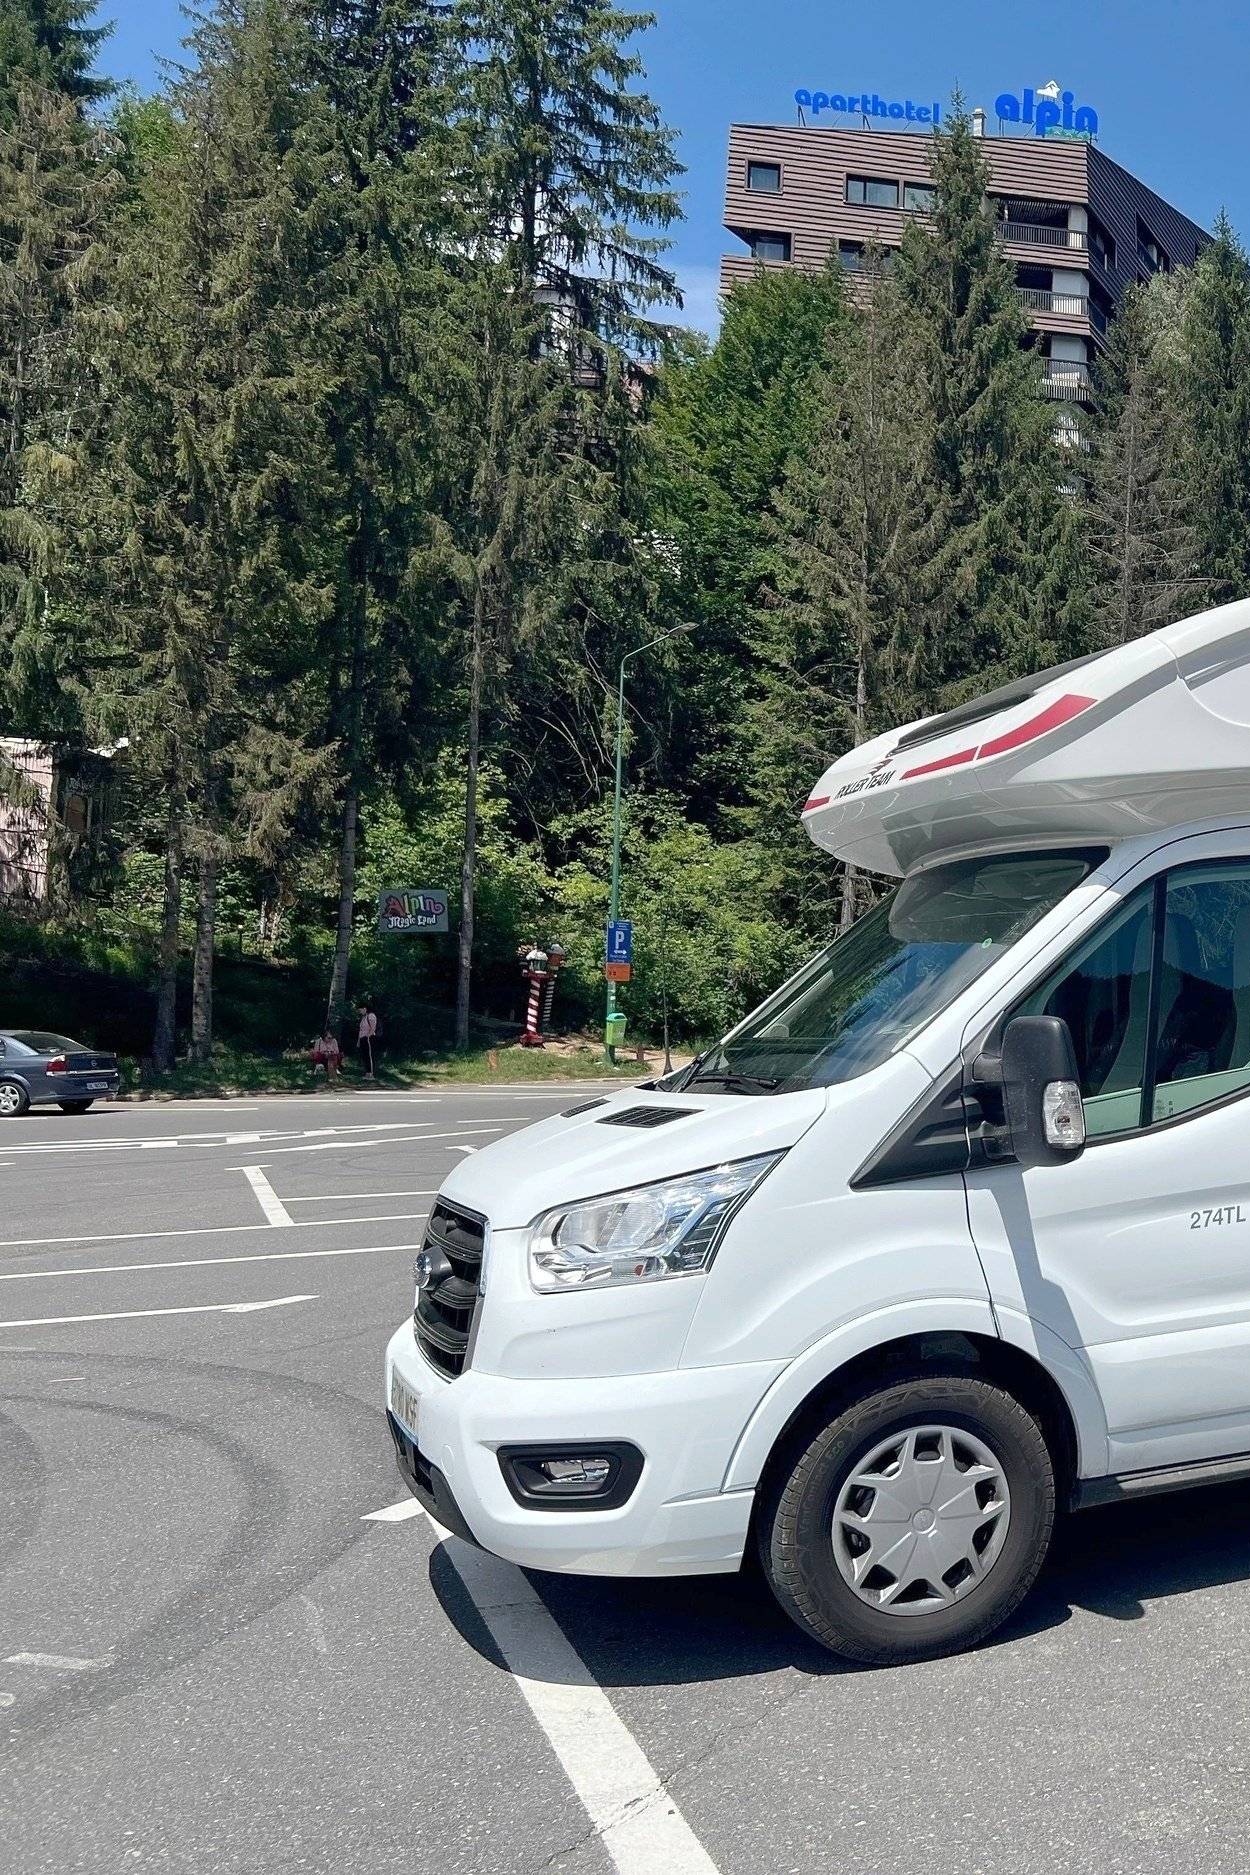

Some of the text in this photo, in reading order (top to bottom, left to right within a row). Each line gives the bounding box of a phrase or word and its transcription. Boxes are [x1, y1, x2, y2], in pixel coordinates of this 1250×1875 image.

[794, 87, 1099, 137] aparthotel alpin
[865, 769, 897, 790] TEAM
[383, 892, 446, 918] Alpin
[387, 913, 436, 929] Magic Land
[614, 930, 625, 950] P
[1189, 1205, 1247, 1230] 274TL
